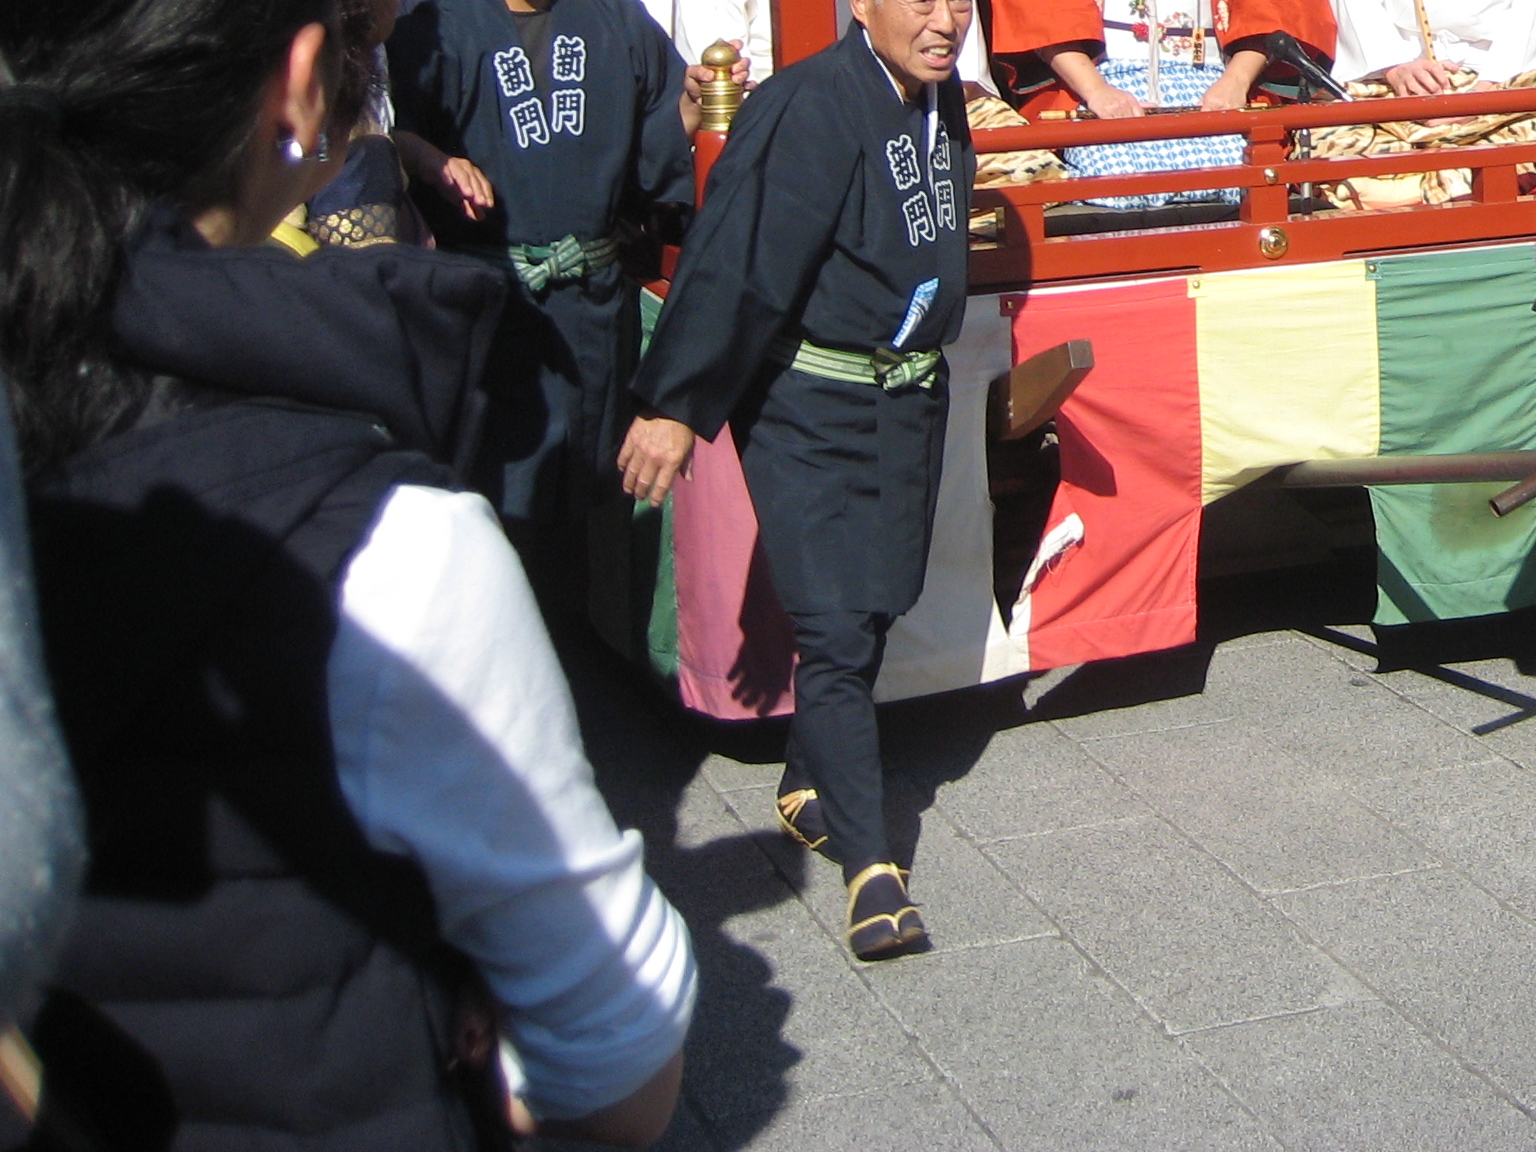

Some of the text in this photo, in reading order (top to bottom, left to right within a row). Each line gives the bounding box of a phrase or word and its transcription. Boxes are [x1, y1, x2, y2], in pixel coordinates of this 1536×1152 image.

[494, 47, 550, 149] 新門
[552, 34, 587, 136] 新門
[886, 134, 937, 247] 新門
